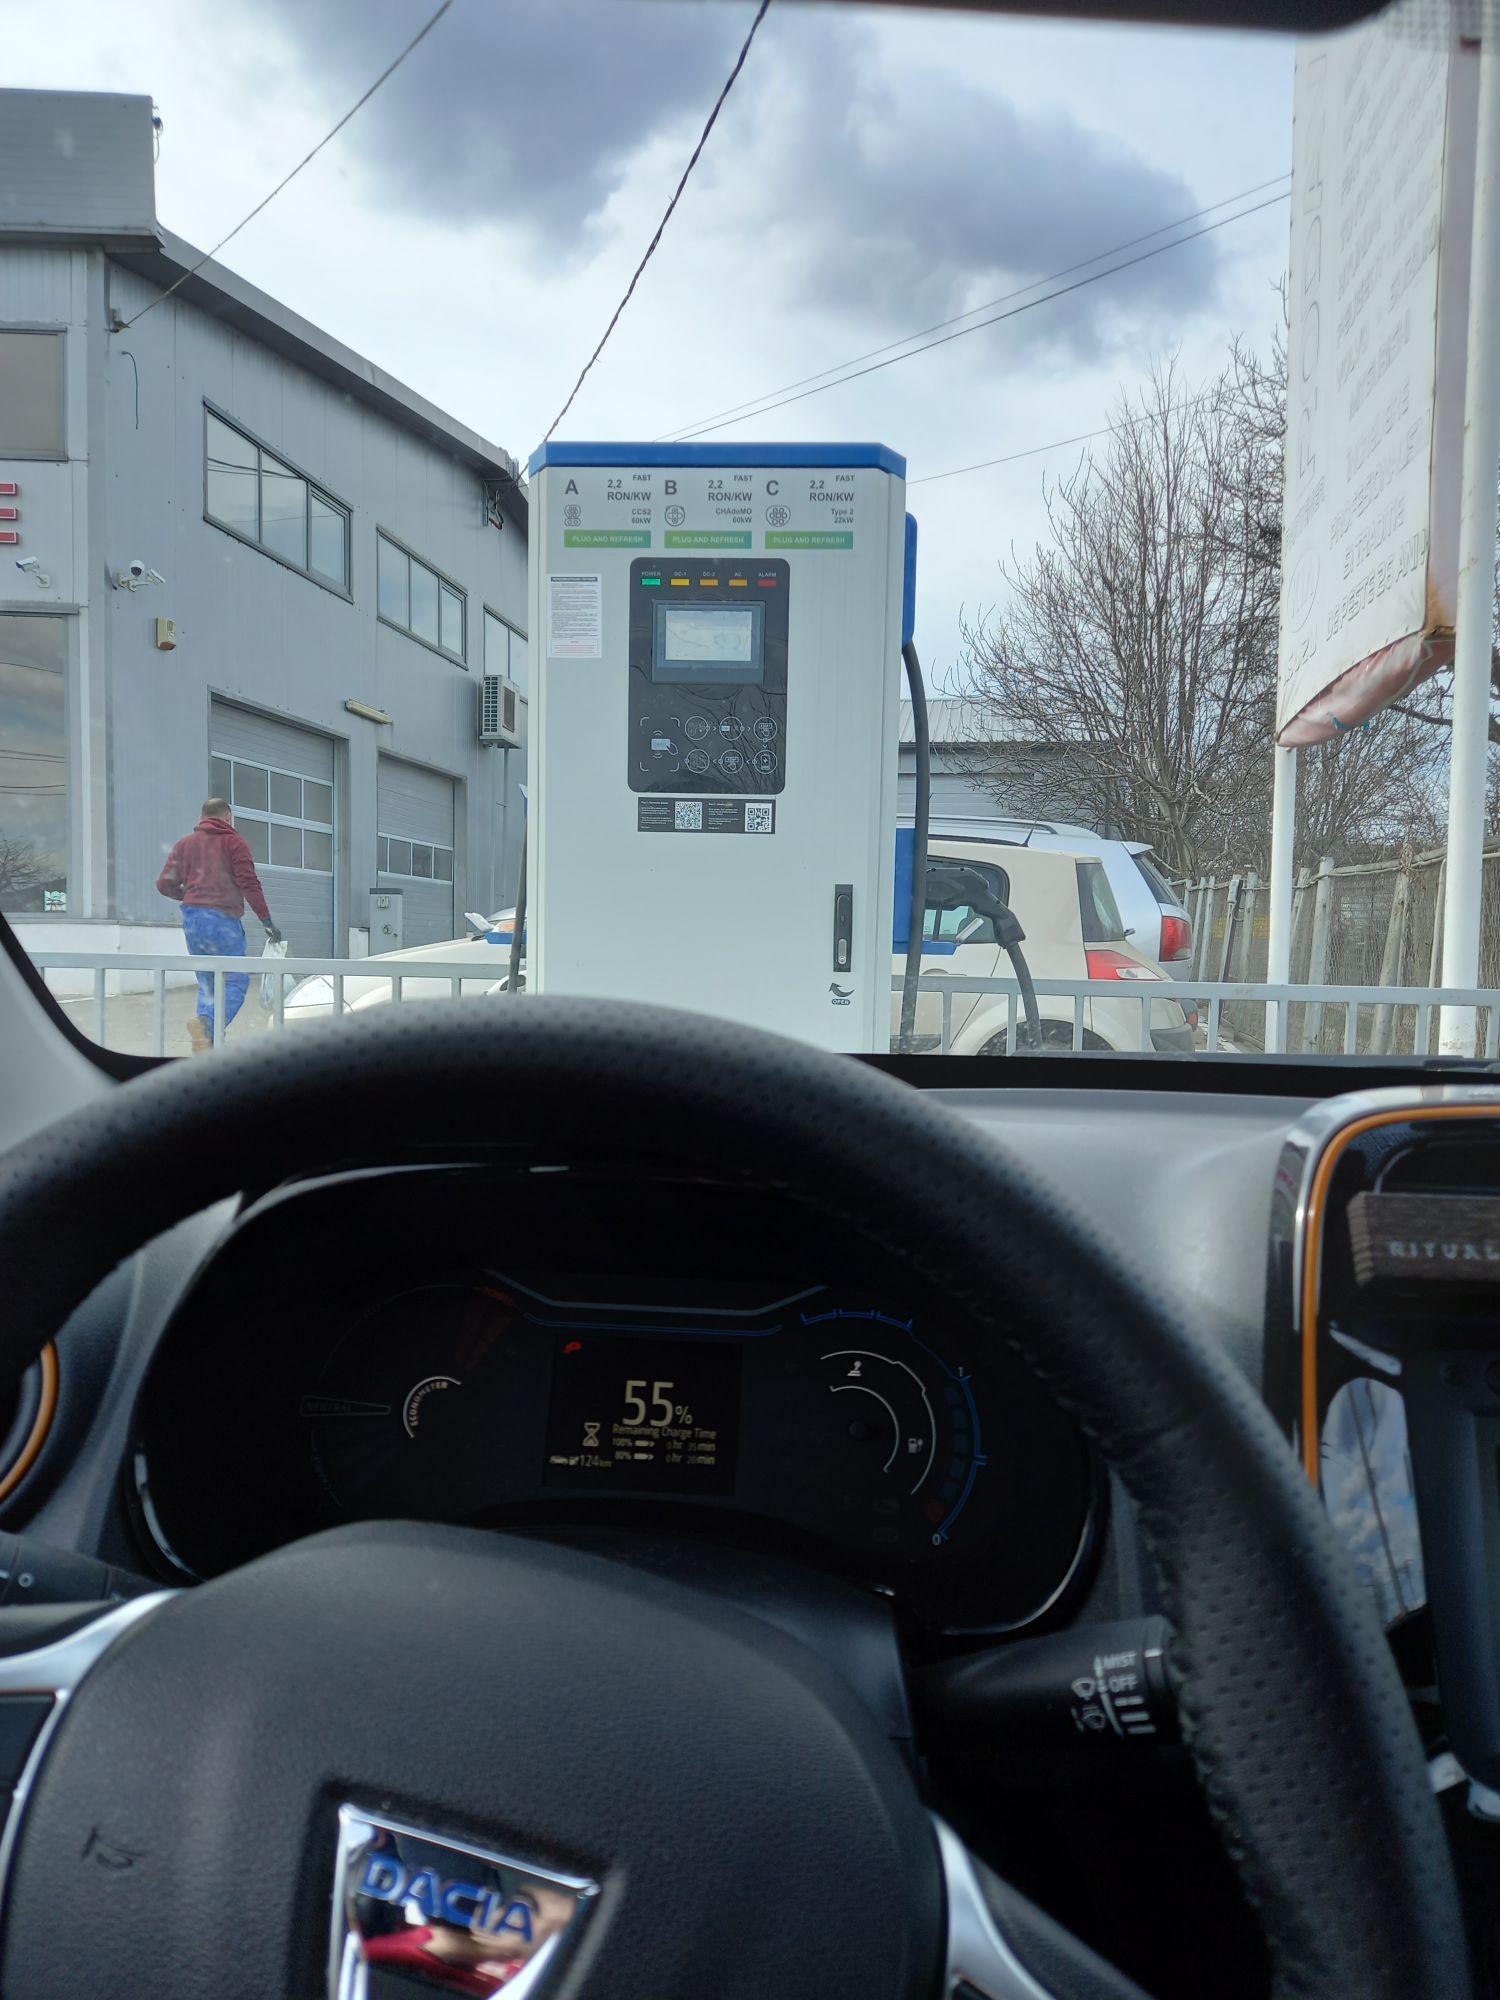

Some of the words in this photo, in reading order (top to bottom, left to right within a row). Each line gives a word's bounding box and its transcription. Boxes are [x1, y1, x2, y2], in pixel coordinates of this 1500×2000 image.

[734, 474, 752, 482] FAST
[836, 474, 854, 482] FAST
[565, 479, 578, 495] A
[608, 480, 622, 489] 2,2
[665, 480, 677, 495] B
[708, 480, 723, 490] 2,2
[766, 480, 779, 496] C
[810, 480, 824, 490] 2,2
[607, 492, 651, 501] RON/KW
[708, 492, 752, 501] RON/KW
[810, 492, 854, 502] RON/KW
[612, 1423, 660, 1438] Remaining
[661, 1426, 692, 1441] Charge
[694, 1428, 717, 1440] Time
[1103, 1651, 1137, 1670] MIST
[1109, 1674, 1138, 1693] OFF
[358, 1853, 536, 1943] DACIA
